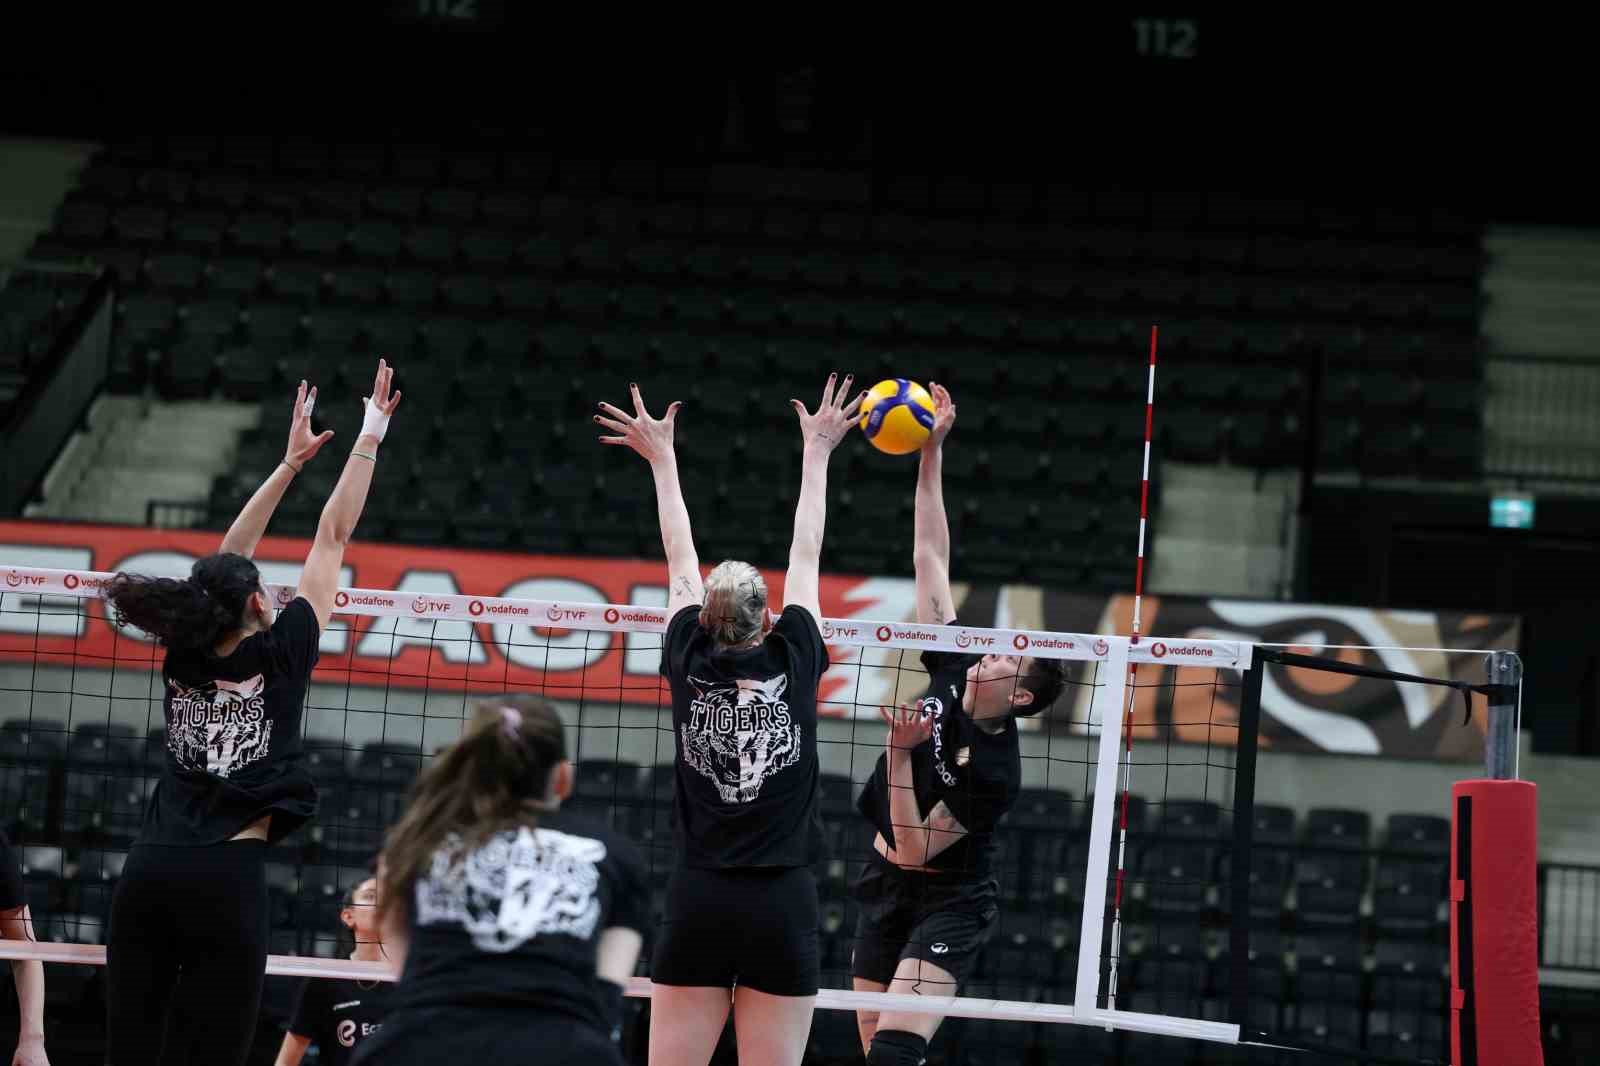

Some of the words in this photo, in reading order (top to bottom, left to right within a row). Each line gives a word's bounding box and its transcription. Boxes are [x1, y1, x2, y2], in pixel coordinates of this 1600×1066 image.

[1134, 18, 1197, 57] 112
[23, 574, 46, 586] TVF
[350, 595, 395, 607] vodafone
[429, 601, 451, 612] TVF
[485, 604, 529, 615] vodafone
[564, 610, 587, 620] TVF
[621, 612, 665, 624] vodafone
[835, 627, 858, 638] TVF
[893, 629, 938, 641] vodafone
[973, 636, 995, 647] TVF
[1031, 638, 1075, 649] vodafone
[1168, 646, 1213, 657] vodafone
[171, 696, 265, 728] TIGERS
[690, 700, 792, 734] TIGERS
